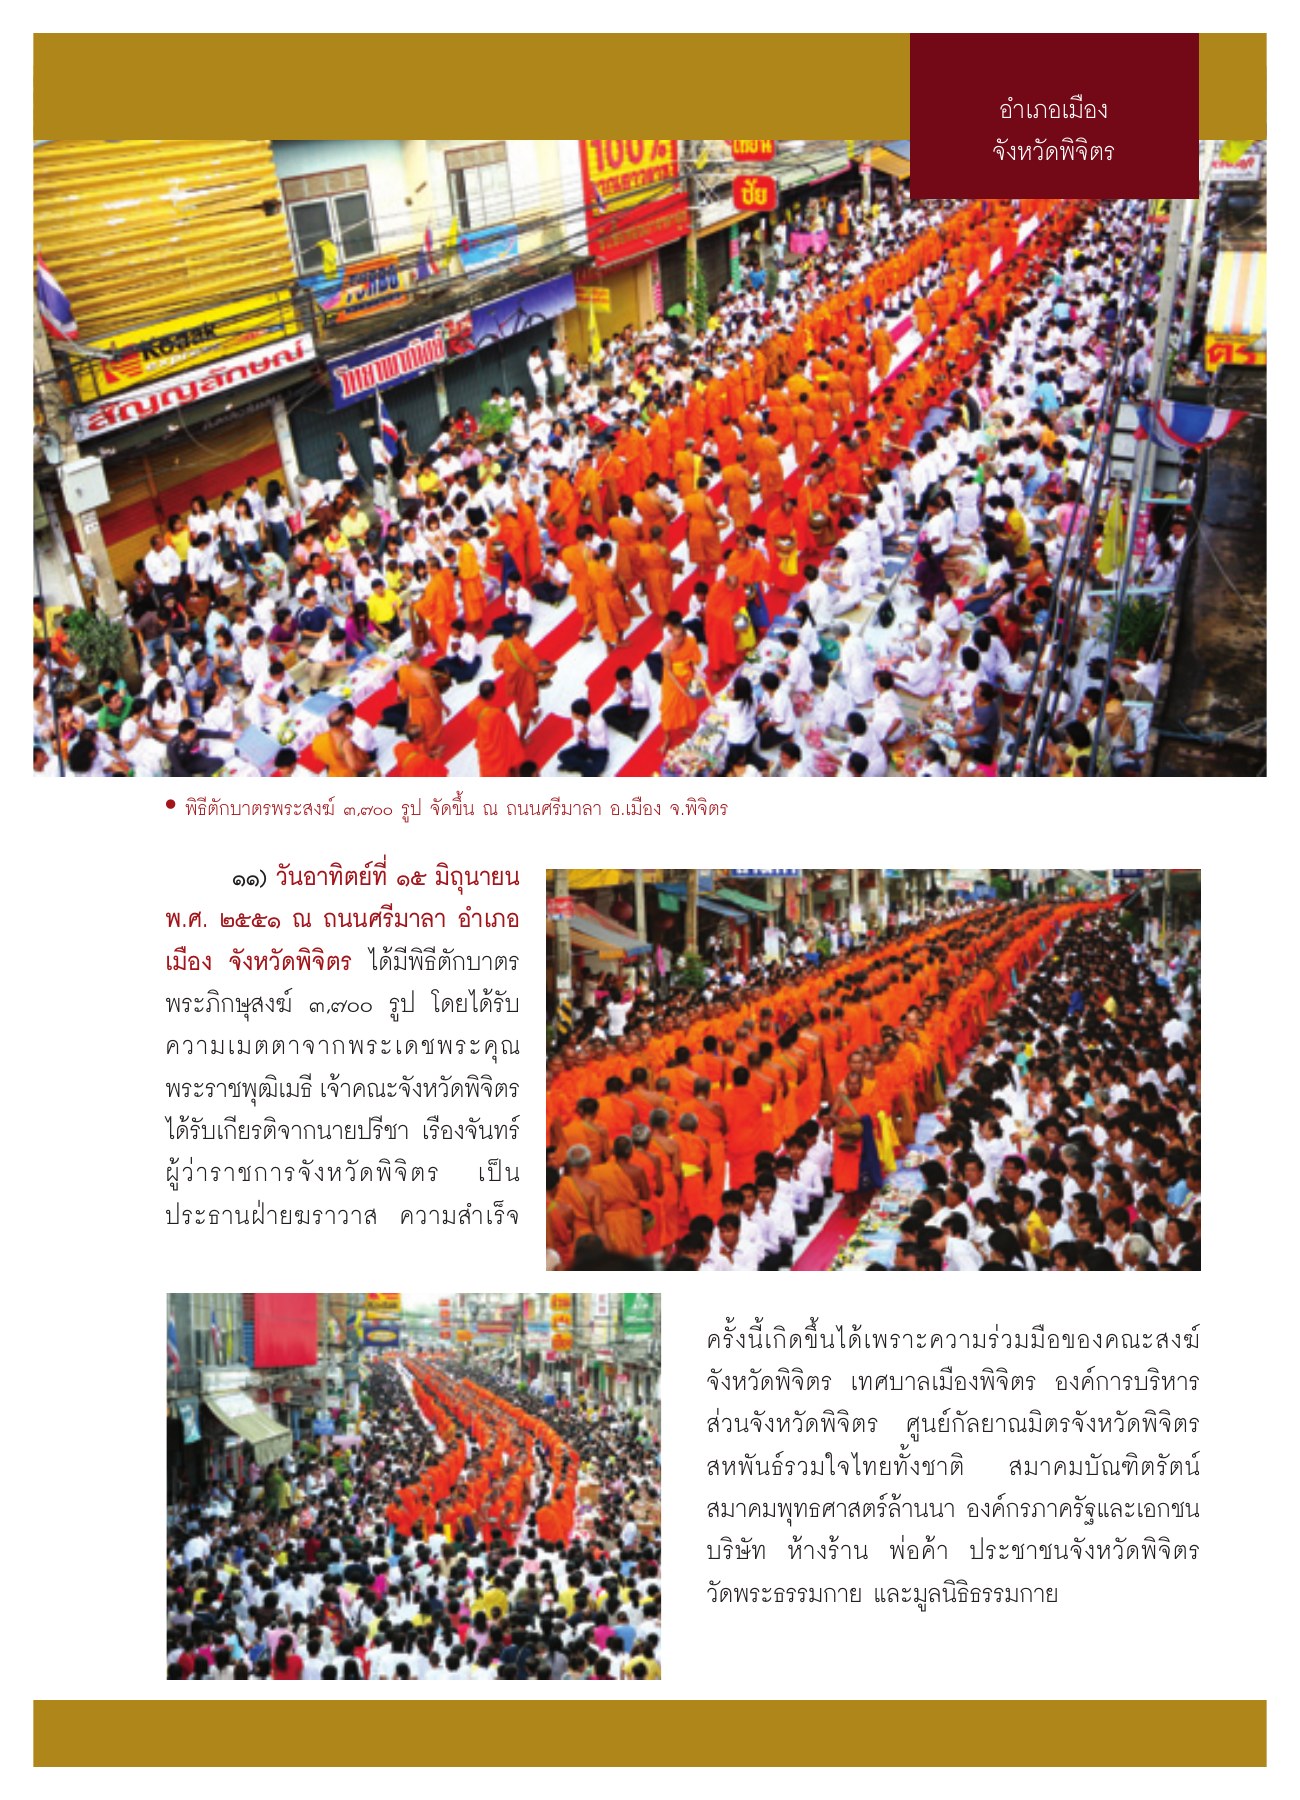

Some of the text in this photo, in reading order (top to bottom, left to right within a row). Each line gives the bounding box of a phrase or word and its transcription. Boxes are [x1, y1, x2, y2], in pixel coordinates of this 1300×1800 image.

[999, 93, 1108, 119] อำเภอเมือง
[992, 136, 1115, 161] จังหวัดพิจิตร
[232, 853, 520, 897] ๑๑) วันอาทิตย์ที่ ๑๕ มิถุนายน
[165, 902, 519, 930] พ.ศ. ๒๕๕๑ ณ ถนนศรีมาลา อำเภอ
[166, 945, 520, 971] เมือง จังหวัดพิจิตร ได้มีพิธีตักบาตร
[165, 987, 519, 1023] พระภิกษุสงฆ์ ๓,๗๐๐ รูป โดยได้รับ
[166, 1037, 521, 1065] ความเมตตาจากพระเดชพระคุณ
[165, 1072, 520, 1108] พระราชพุฒิเมธี เจ้าคณะจังหวัดพิจิตร
[163, 1114, 521, 1140] ได้รับเกียรติจากนายปรีชา เรืองจันทร์
[166, 1156, 520, 1192] ผู้ว่าราชการจังหวัดพิจิตร เป็น
[165, 1199, 519, 1225] ประธานฝ่ายฆราวาส ความสำเร็จ
[707, 1316, 1201, 1349] ครั้งนี้เกิดขึ้นได้เพราะความร่วมมือของคณะสงฆ์
[706, 1365, 1200, 1391] จังหวัดพิจิตร เทศบาลเมืองพิจิตร องค์การบริหาร
[706, 1407, 1200, 1443] ส่วนจังหวัดพิจิตร ศูนย์กัลยาณมิตรจังหวัดพิจิตร
[706, 1443, 1201, 1476] สหพันธ์รวมใจไทยทั้งชาติ สมาคมบัณฑิตรัตน์
[706, 1492, 1200, 1528] สมาคมพุทธศาสตร์ล้านนา องค์กรภาครัฐและเอกชน
[706, 1534, 1200, 1560] บริษัท ห้างร้าน พ่อค้า ประชาชนจังหวัดพิจิตร
[706, 1578, 1058, 1613] วัดพระธรรมกาย และมูลนิธิธรรมกาย
